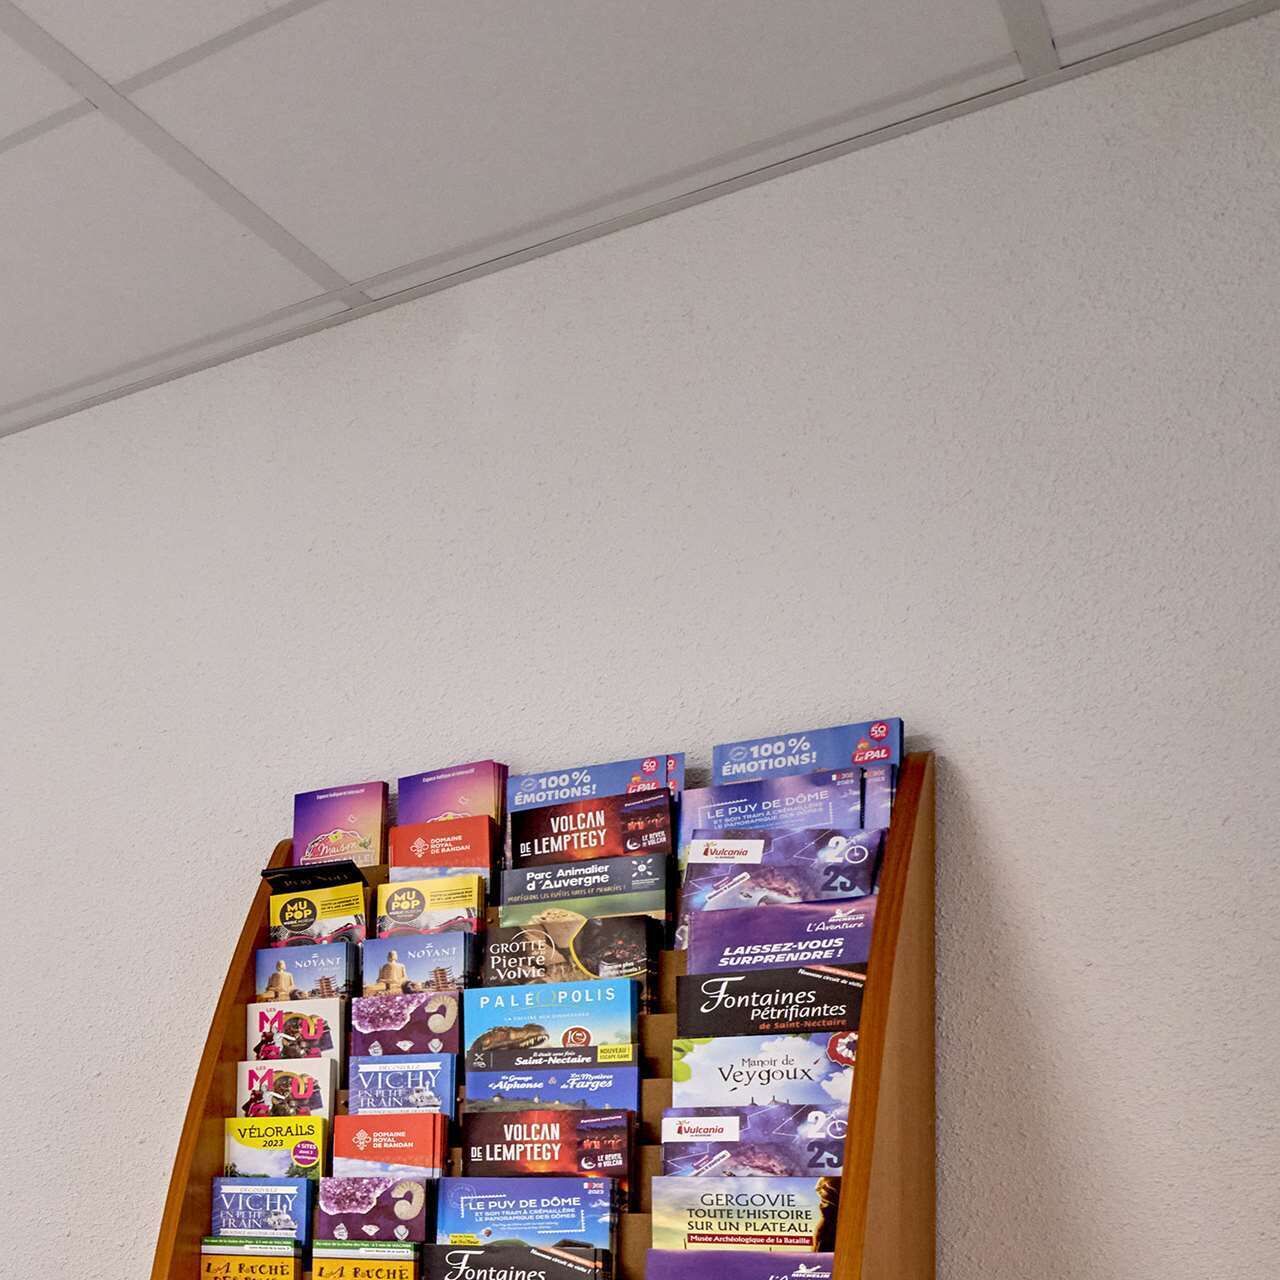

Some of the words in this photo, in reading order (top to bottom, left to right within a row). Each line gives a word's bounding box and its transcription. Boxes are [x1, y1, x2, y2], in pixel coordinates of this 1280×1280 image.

[750, 743, 784, 759] 100
[538, 774, 570, 790] 100
[707, 807, 725, 820] LE
[728, 802, 758, 816] PUY
[761, 799, 781, 811] DE
[784, 790, 830, 808] DÔME
[550, 810, 605, 833] VOLCAN
[520, 841, 532, 857] DE
[534, 829, 608, 855] LEMPTEGY
[709, 846, 749, 857] Vulcania
[527, 870, 552, 881] Parc
[556, 865, 610, 878] Animalier
[392, 898, 420, 911] POP
[285, 908, 313, 920] POP
[407, 946, 458, 960] NOYANT
[490, 940, 546, 955] GROTTE
[722, 938, 844, 957] LAISSEZ-VOUS
[294, 956, 342, 969] NOYANT
[490, 955, 546, 970] Pierre
[718, 951, 833, 967] SURPRENDRE
[497, 966, 546, 981] Volvic
[700, 975, 817, 1014] Fontaines
[750, 1003, 847, 1022] Pétrifiantes
[759, 1022, 771, 1031] de
[774, 1018, 848, 1030] Saint-Nectaire
[514, 1055, 592, 1066] Saint-Nectaire
[741, 1056, 778, 1068] Manoir
[781, 1055, 795, 1066] de
[359, 1071, 441, 1089] VICHY
[718, 1064, 815, 1086] Veygoux
[568, 1078, 613, 1091] Farges
[359, 1097, 403, 1108] TRAIN
[504, 1123, 560, 1141] VOLCAN
[683, 1125, 724, 1135] Vulcania
[471, 1147, 482, 1161] DE
[486, 1143, 561, 1161] LEMPTEGY
[221, 1193, 298, 1211] VICHY
[469, 1200, 486, 1210] LE
[489, 1200, 515, 1209] PUY
[518, 1199, 537, 1208] DE
[541, 1196, 581, 1206] DÔME
[700, 1193, 796, 1207] GERGOVIE
[688, 1208, 734, 1219] TOUTE
[736, 1209, 812, 1220] L'HISTOIRE
[688, 1220, 712, 1231] SUR
[718, 1222, 739, 1231] UN
[747, 1222, 812, 1232] PLATEAU.
[690, 1235, 712, 1243] Musée
[712, 1236, 763, 1245] Archéologique
[784, 1237, 810, 1245] Bataille
